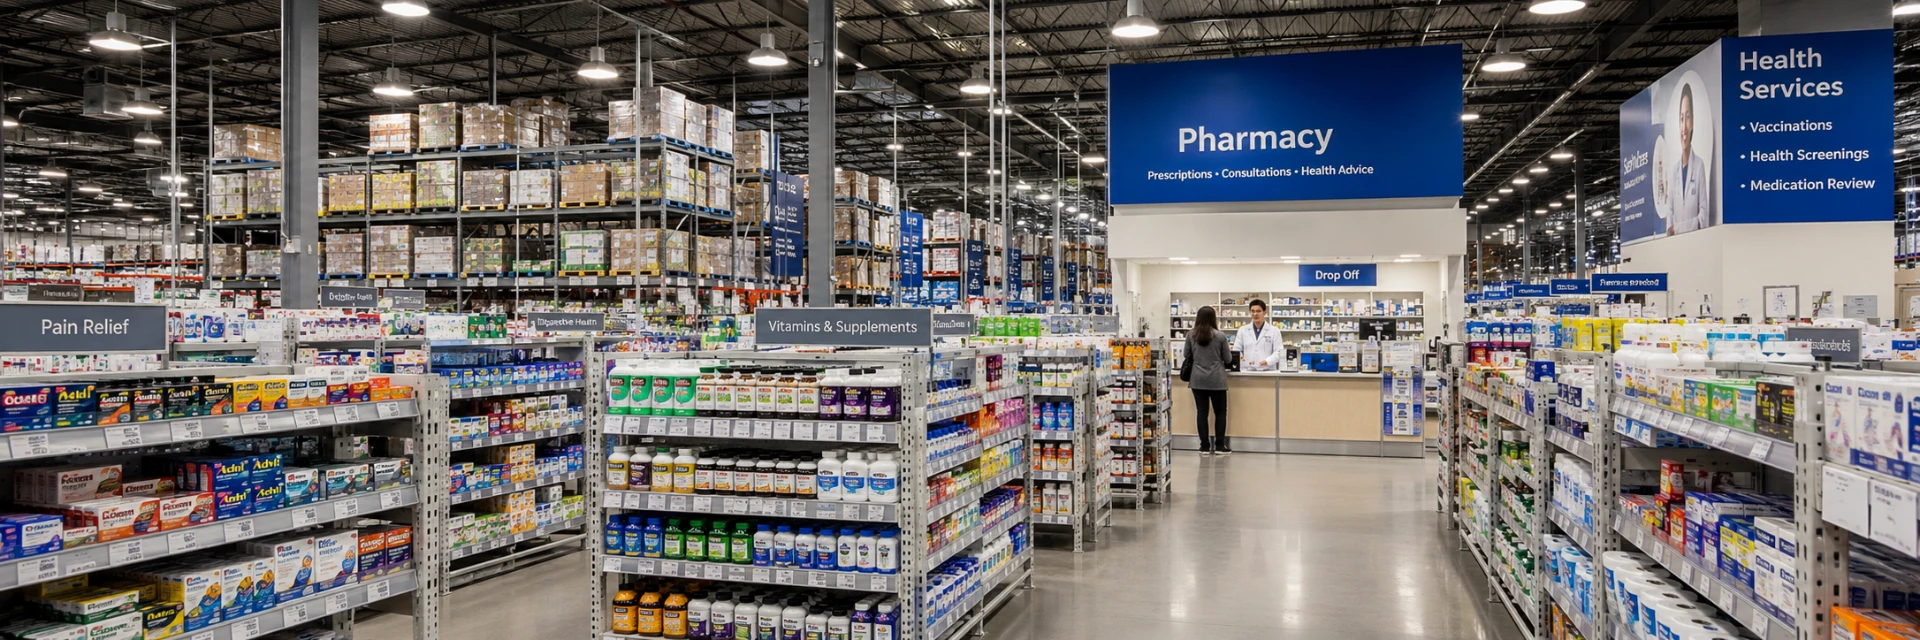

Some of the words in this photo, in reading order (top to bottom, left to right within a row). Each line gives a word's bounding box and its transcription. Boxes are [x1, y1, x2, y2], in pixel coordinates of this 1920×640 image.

[1739, 47, 1823, 72] Health
[1739, 77, 1844, 101] Services
[1750, 119, 1833, 133] Vaccinations
[1178, 125, 1334, 156] Pharmacy
[1750, 149, 1794, 162] Health
[1797, 147, 1870, 163] Screenings
[1147, 169, 1213, 182] Prescriptions
[1221, 166, 1292, 179] Consultations
[1301, 164, 1336, 176] Health
[1338, 164, 1374, 175] Advice
[1750, 178, 1824, 192] Medication
[1827, 177, 1876, 190] Review
[1315, 269, 1341, 283] Drop
[1343, 269, 1360, 280] Off
[41, 318, 78, 335] Pain
[83, 318, 130, 335] Relief
[768, 320, 821, 333] Vitamins
[823, 320, 834, 333] &
[836, 320, 918, 336] Supplements
